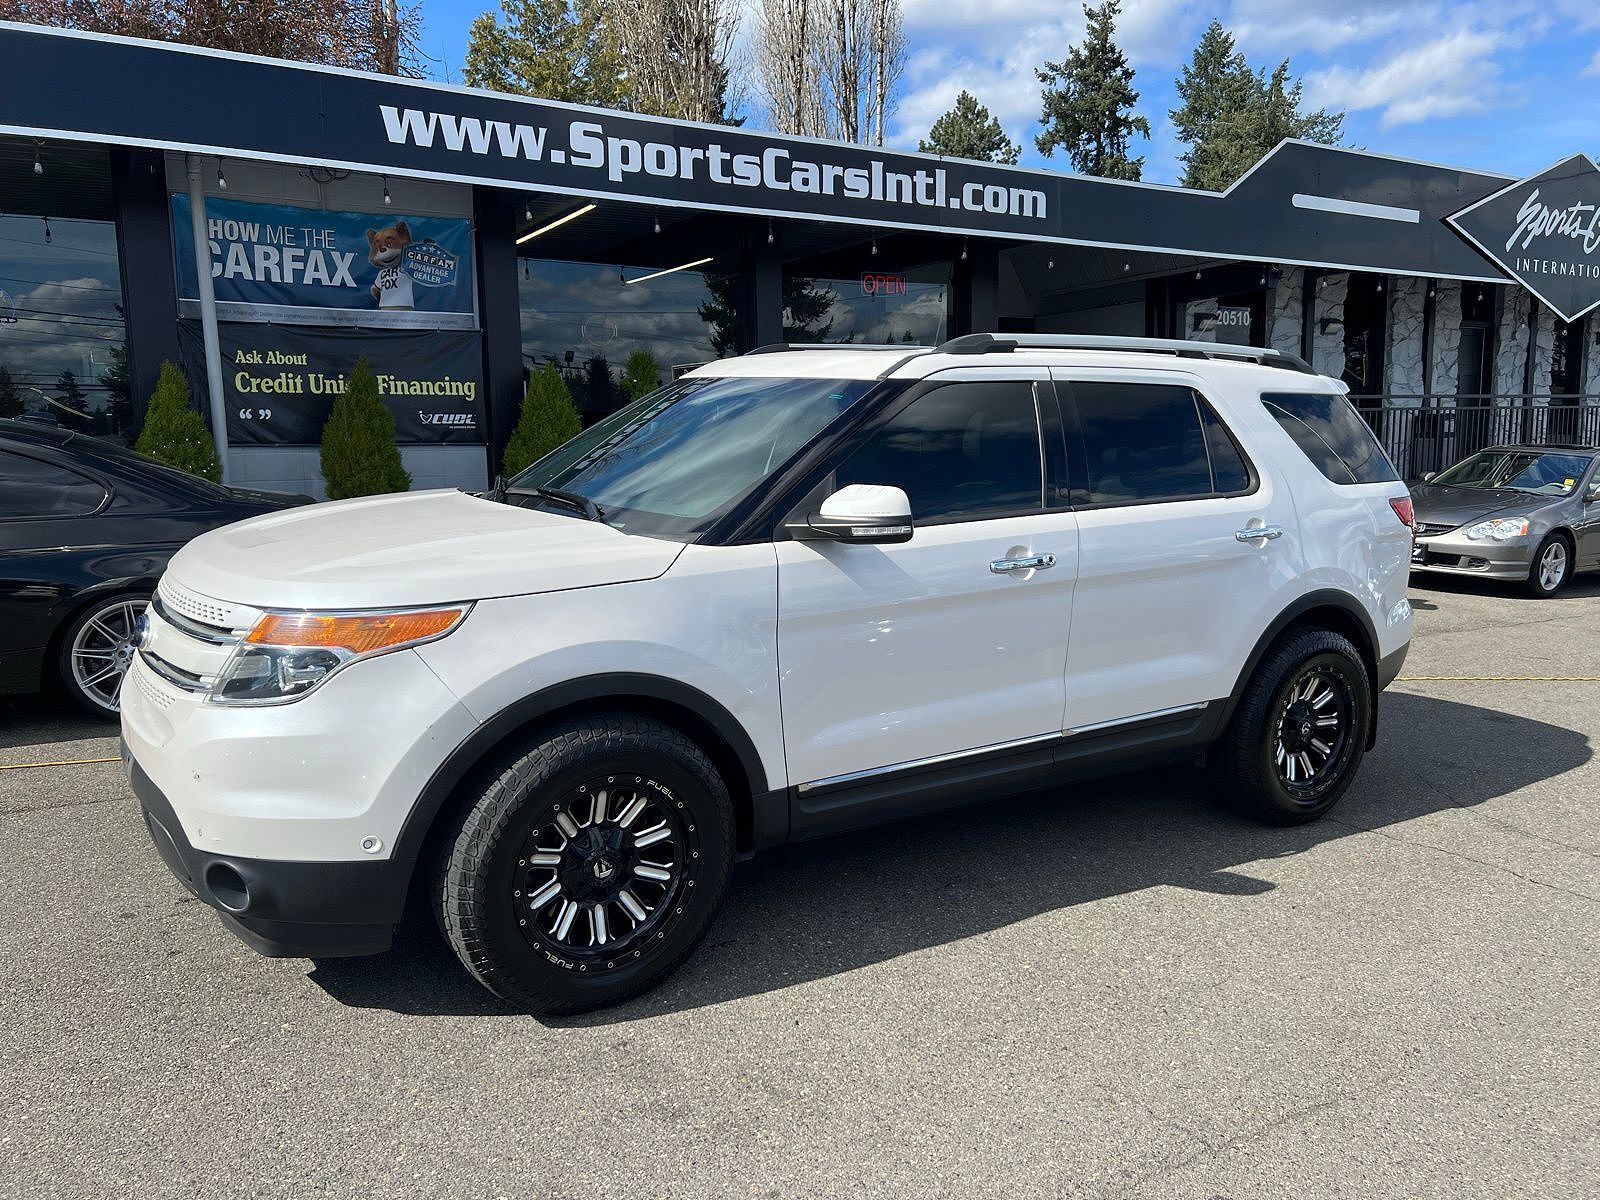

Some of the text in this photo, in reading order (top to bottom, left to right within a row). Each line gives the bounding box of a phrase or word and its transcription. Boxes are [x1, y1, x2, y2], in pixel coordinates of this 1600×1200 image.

[1506, 188, 1594, 253] Sports
[208, 219, 336, 249] HOW ME THE
[407, 251, 454, 270] CARFAX
[408, 261, 449, 278] ADVANTAGE
[1516, 257, 1600, 279] INTERNATIO
[381, 267, 399, 279] CAR
[413, 271, 441, 284] DEALER
[381, 278, 399, 290] FOX
[863, 274, 906, 296] OPEN
[1216, 310, 1251, 326] 20510
[235, 350, 308, 366] Ask About
[234, 371, 476, 401] Credit Uni Financing
[646, 779, 674, 801] FUEL
[544, 950, 574, 970] FUEL
